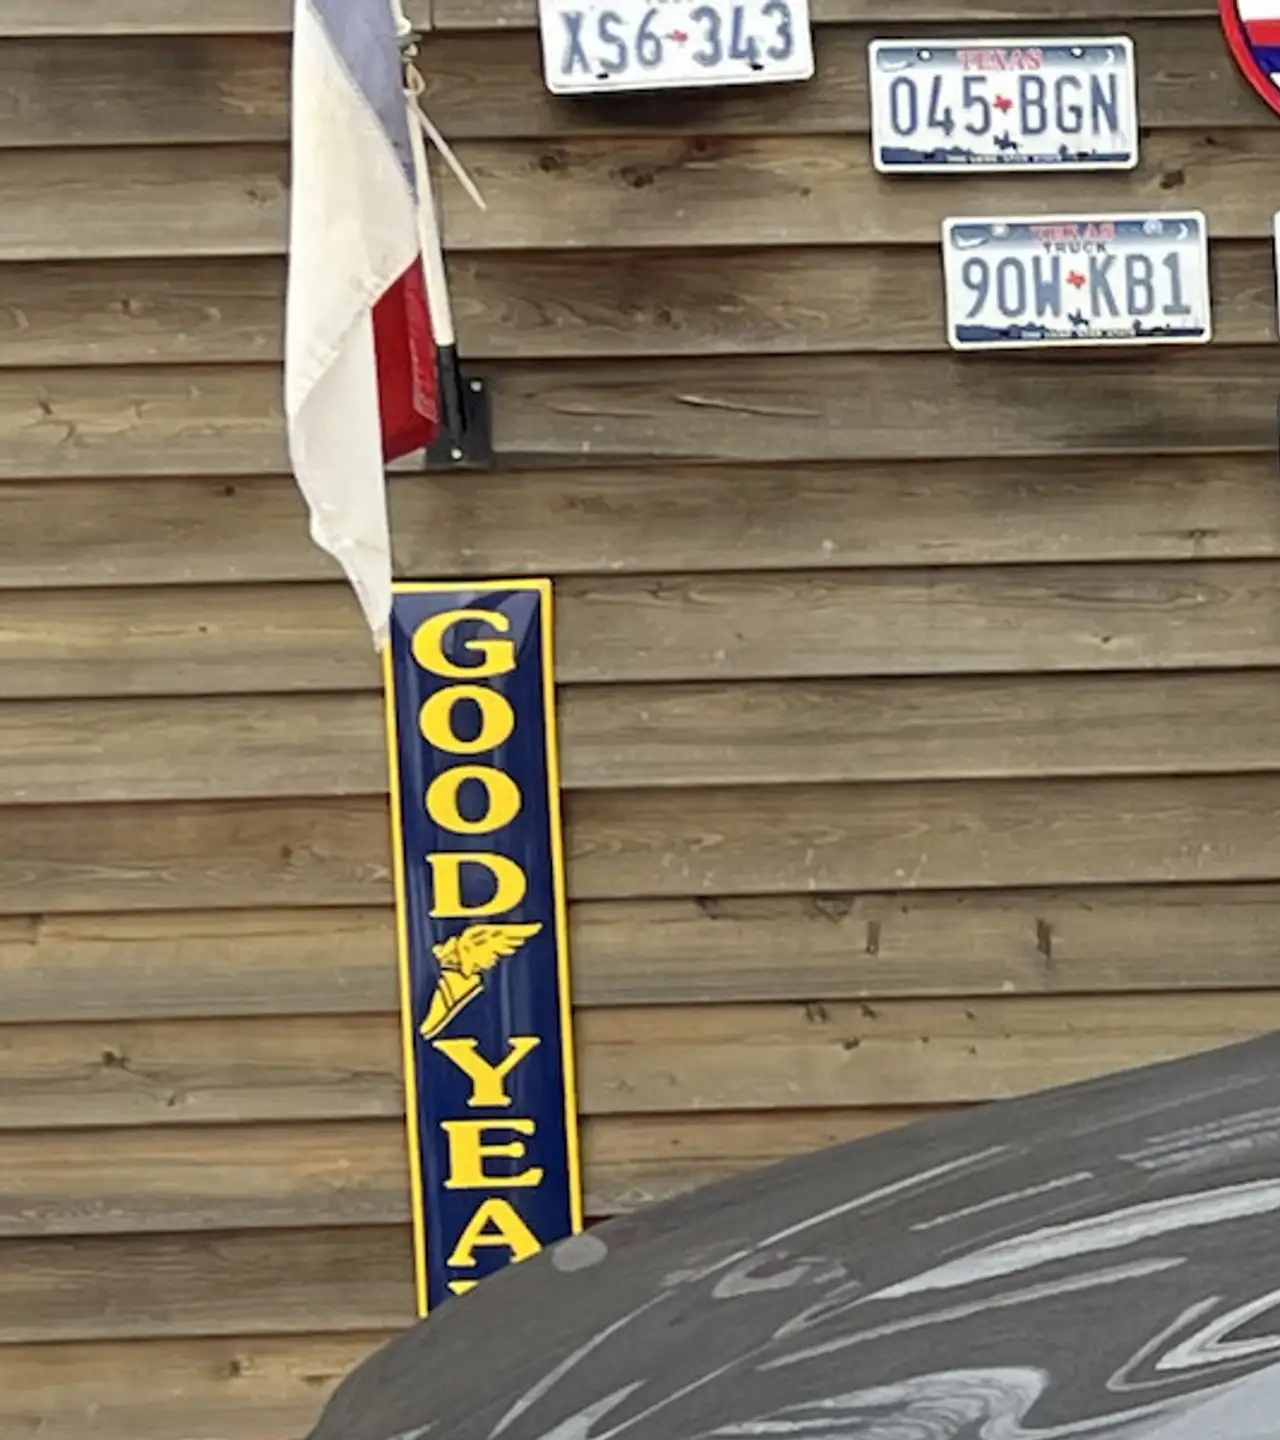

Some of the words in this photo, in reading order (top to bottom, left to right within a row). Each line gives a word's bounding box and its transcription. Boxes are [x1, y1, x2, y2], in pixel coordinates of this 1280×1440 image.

[560, 8, 663, 75] XS6
[690, 1, 794, 67] 343
[1018, 75, 1119, 136] BGN
[1089, 253, 1191, 316] KB1
[411, 609, 543, 1295] GOODYEA
